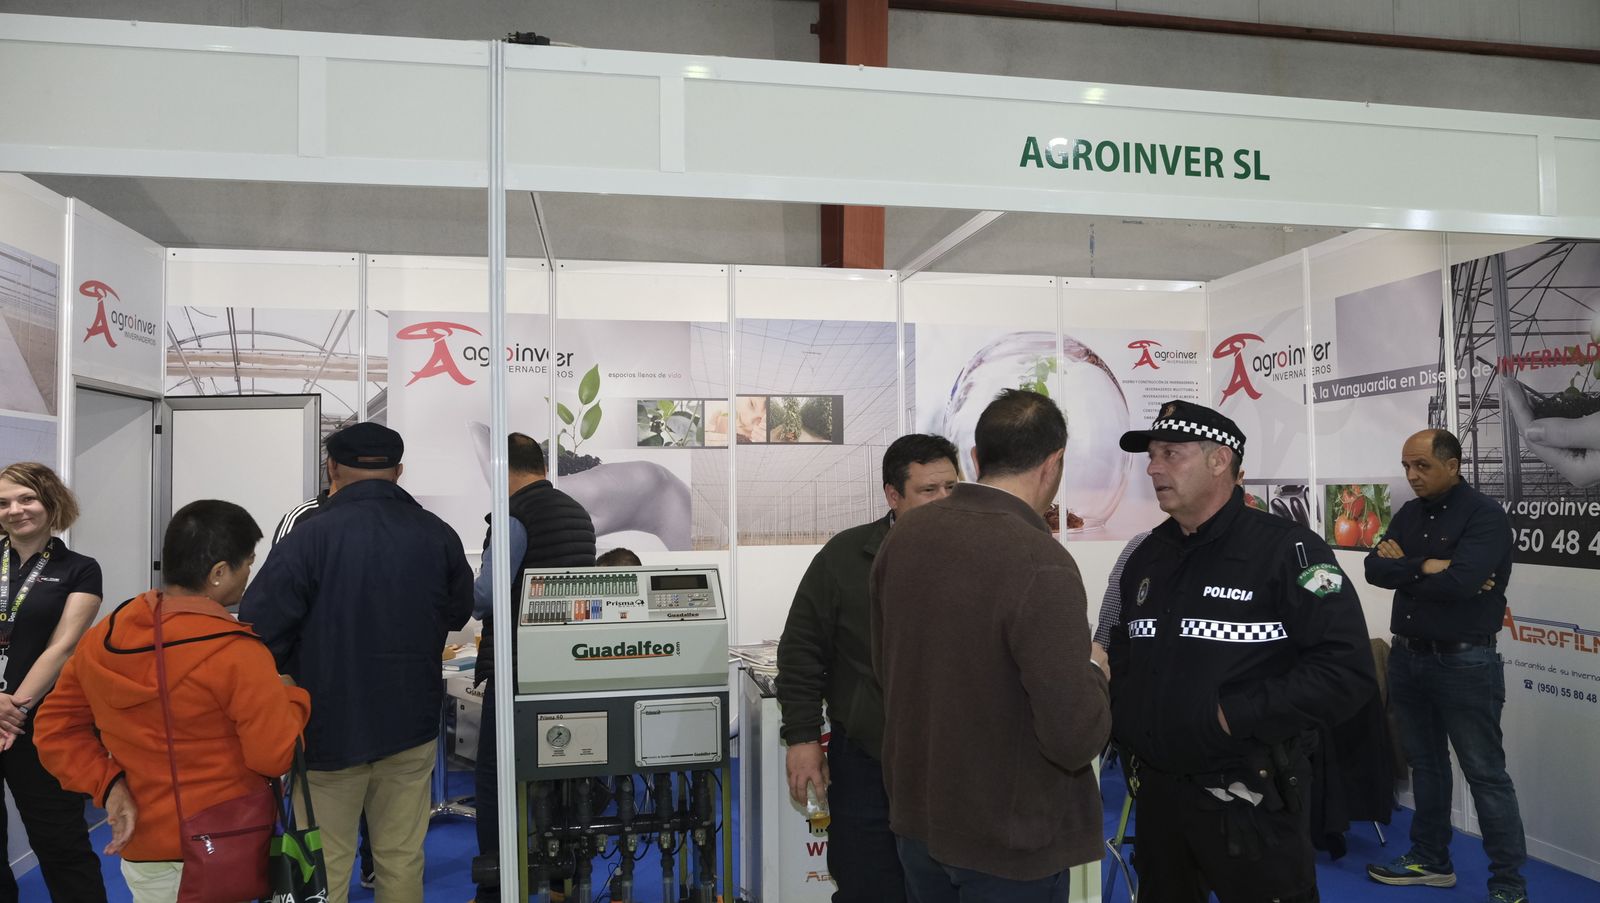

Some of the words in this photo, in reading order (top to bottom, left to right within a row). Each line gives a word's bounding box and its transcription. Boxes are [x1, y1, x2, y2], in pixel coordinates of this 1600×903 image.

[1020, 136, 1225, 179] AGROINVER
[1233, 148, 1271, 181] SL
[111, 310, 156, 336] agroinver
[1154, 350, 1198, 362] agroinver
[1319, 386, 1329, 399] la
[1332, 375, 1397, 398] Vanguardia
[1400, 375, 1416, 388] en
[1471, 362, 1491, 378] de
[1551, 529, 1580, 555] 48
[1203, 586, 1253, 602] POLICIA
[571, 640, 675, 659] Guadalfeo
[1547, 664, 1557, 674] de
[1537, 682, 1558, 697] (950)
[1560, 687, 1571, 698] 55
[1573, 690, 1584, 701] 80
[1586, 692, 1597, 703] 48
